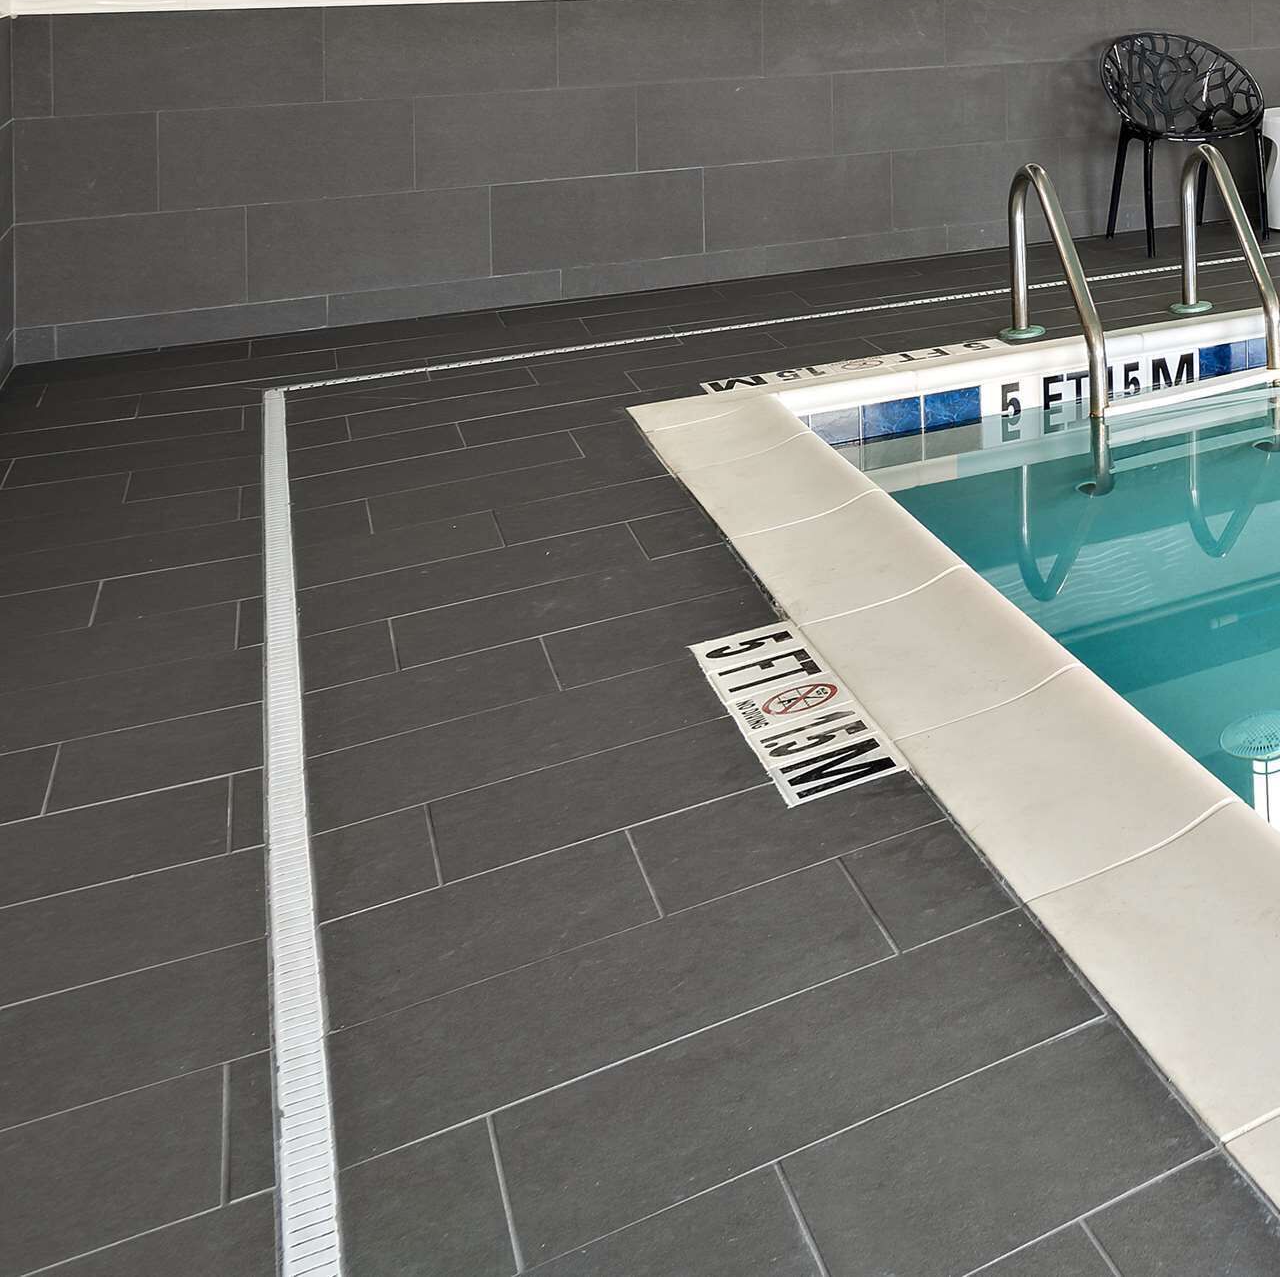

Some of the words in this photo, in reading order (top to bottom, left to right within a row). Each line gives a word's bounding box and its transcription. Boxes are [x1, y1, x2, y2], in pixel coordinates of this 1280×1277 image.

[899, 347, 951, 362] FT
[962, 341, 992, 351] 5
[1001, 382, 1022, 418] 5
[705, 630, 794, 659] 5
[718, 647, 823, 693] FT
[735, 698, 757, 711] NO
[741, 707, 770, 730] DIVING
